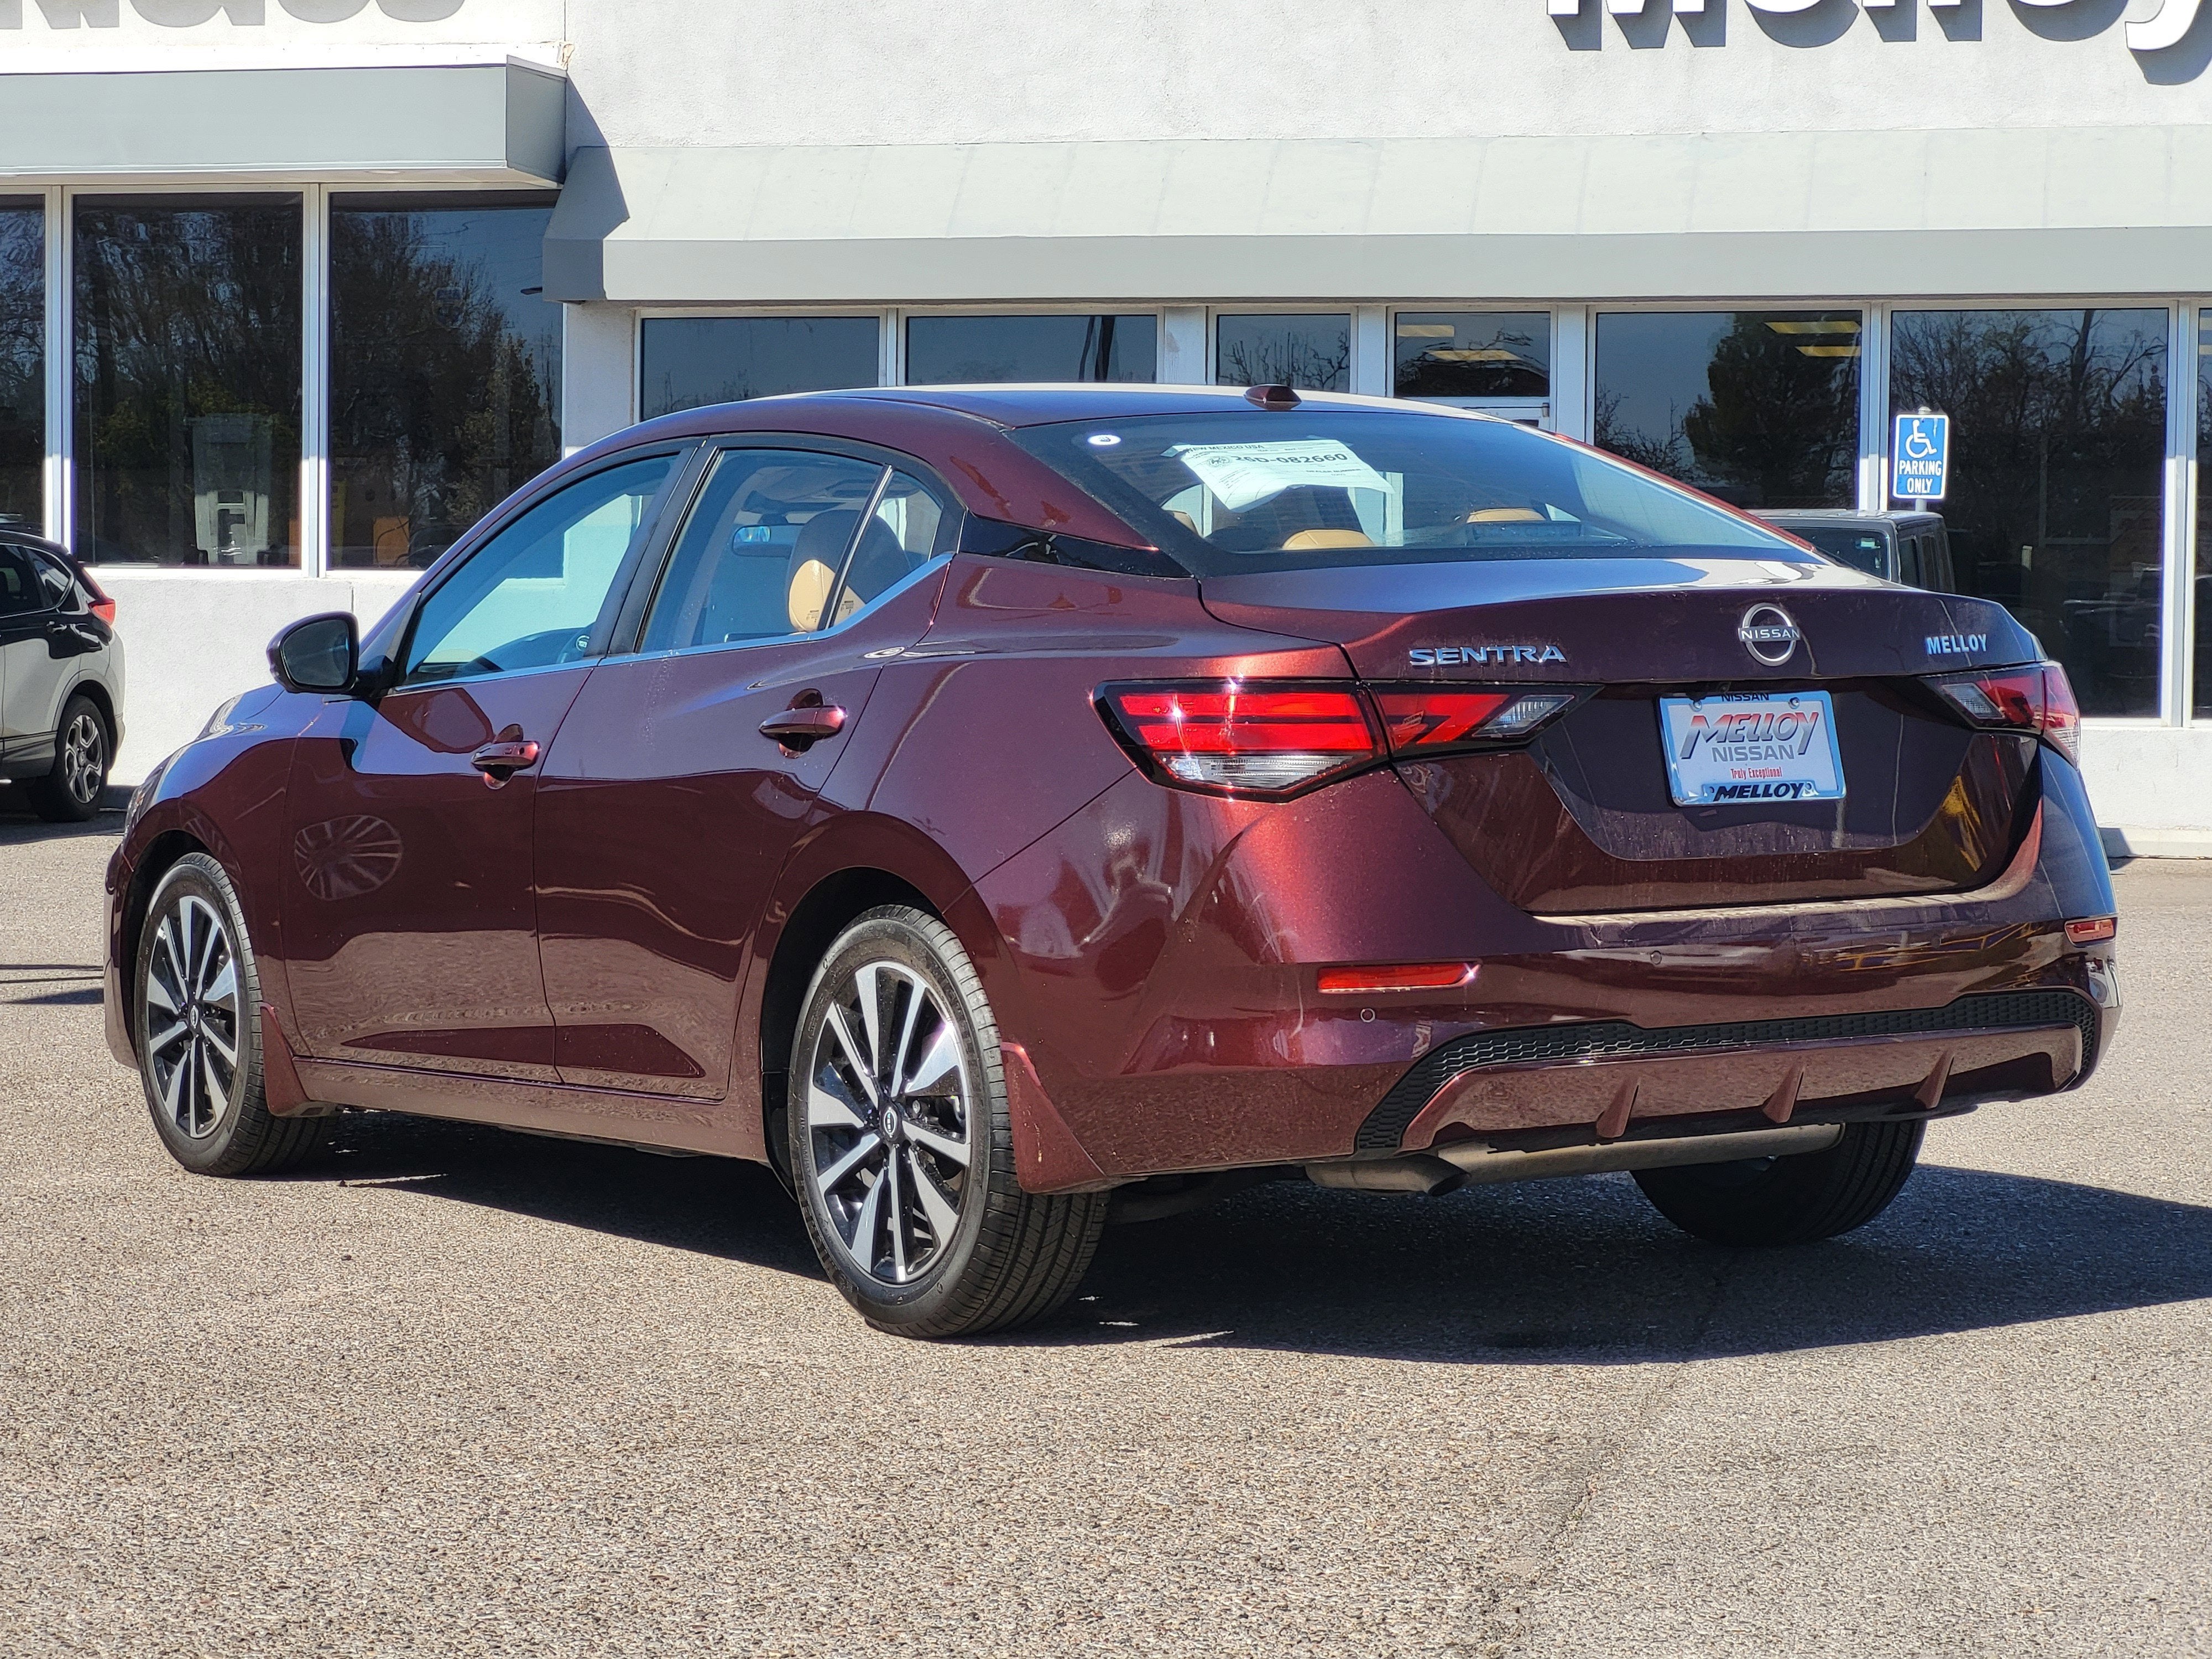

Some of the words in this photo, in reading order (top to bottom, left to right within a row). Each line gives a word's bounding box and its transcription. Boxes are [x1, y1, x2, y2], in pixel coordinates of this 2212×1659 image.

[1899, 460, 1942, 476] PARKING
[1907, 478, 1933, 493] ONLY
[1741, 629, 1799, 639] NISSAN
[1926, 634, 1986, 655] MELLOY
[1409, 645, 1567, 666] SENTRA
[1721, 692, 1770, 702] NISSAN
[1679, 712, 1819, 759] MELLOY
[1712, 744, 1794, 762] NISSAN
[1730, 768, 1746, 780] Truly
[1748, 766, 1783, 779] Exceptional
[1713, 782, 1804, 801] MELLOY
